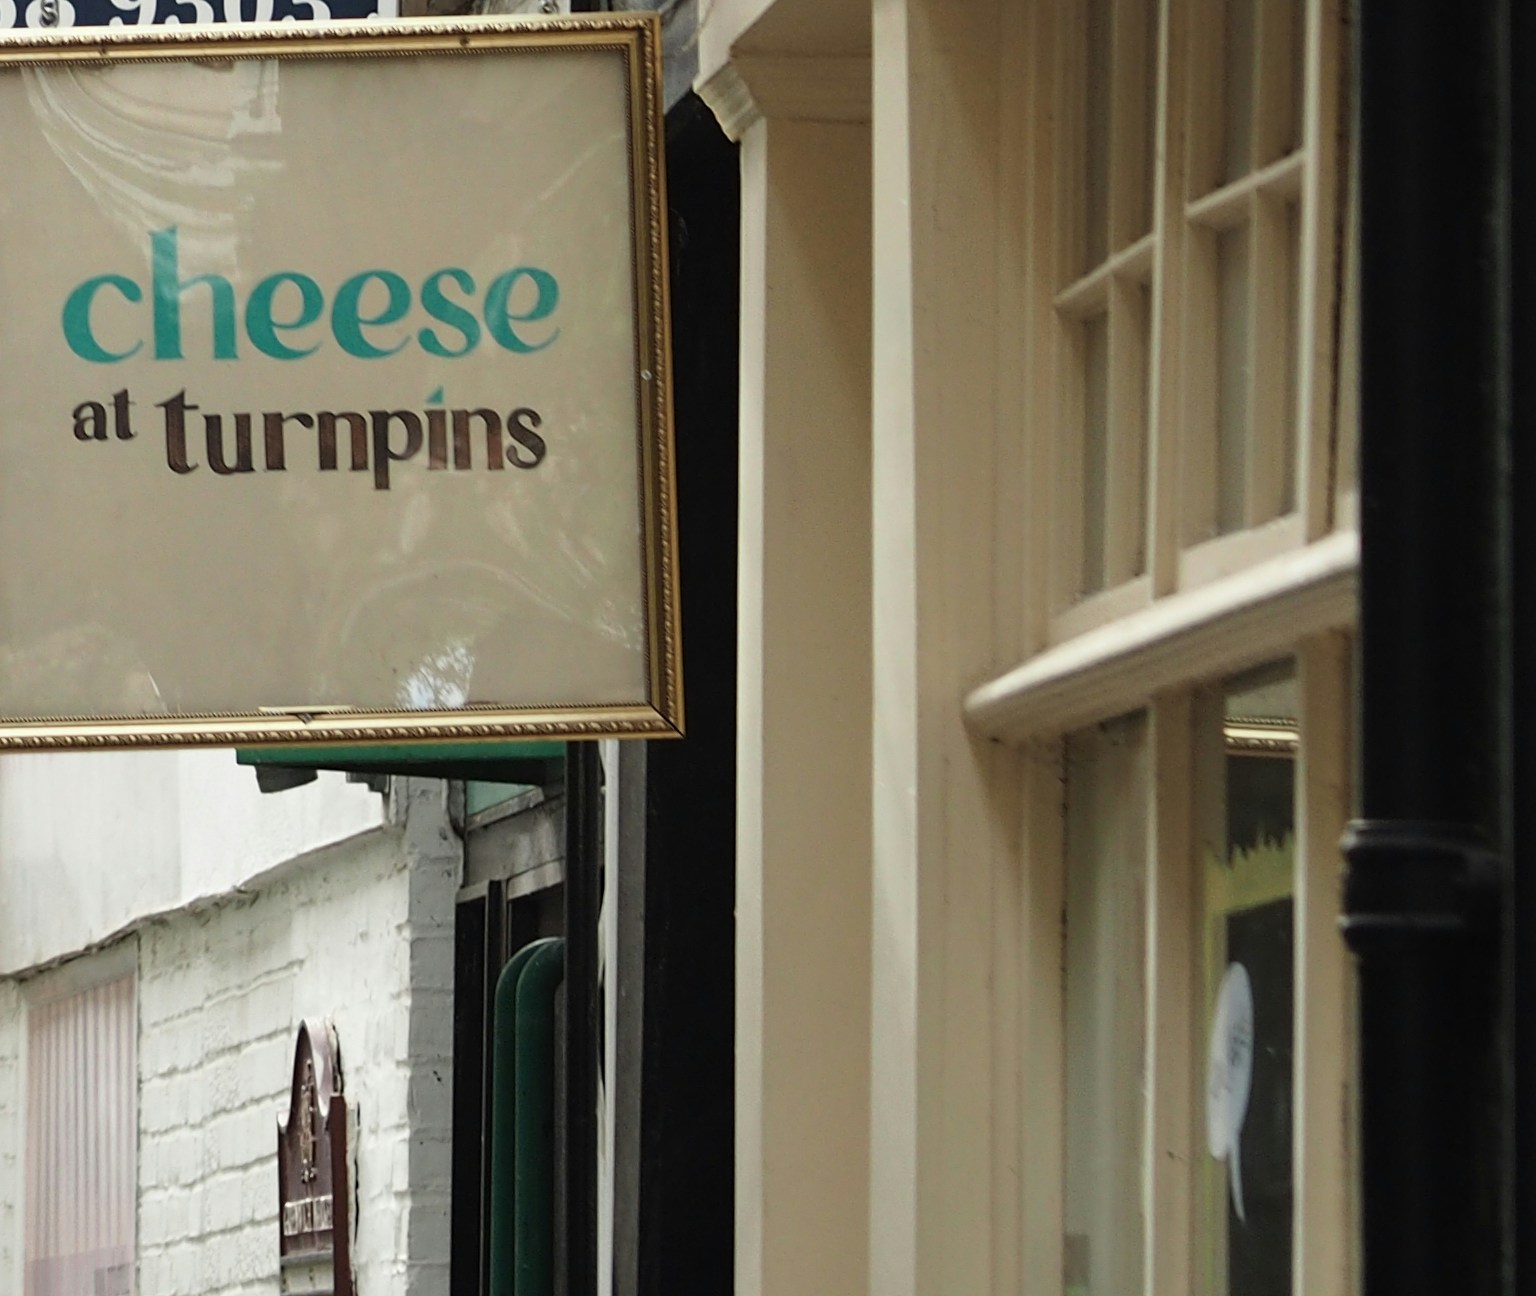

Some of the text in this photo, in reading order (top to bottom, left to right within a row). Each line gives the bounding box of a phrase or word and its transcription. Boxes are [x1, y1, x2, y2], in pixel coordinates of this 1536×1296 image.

[61, 223, 562, 365] cheese
[72, 385, 549, 492] at turnpins
